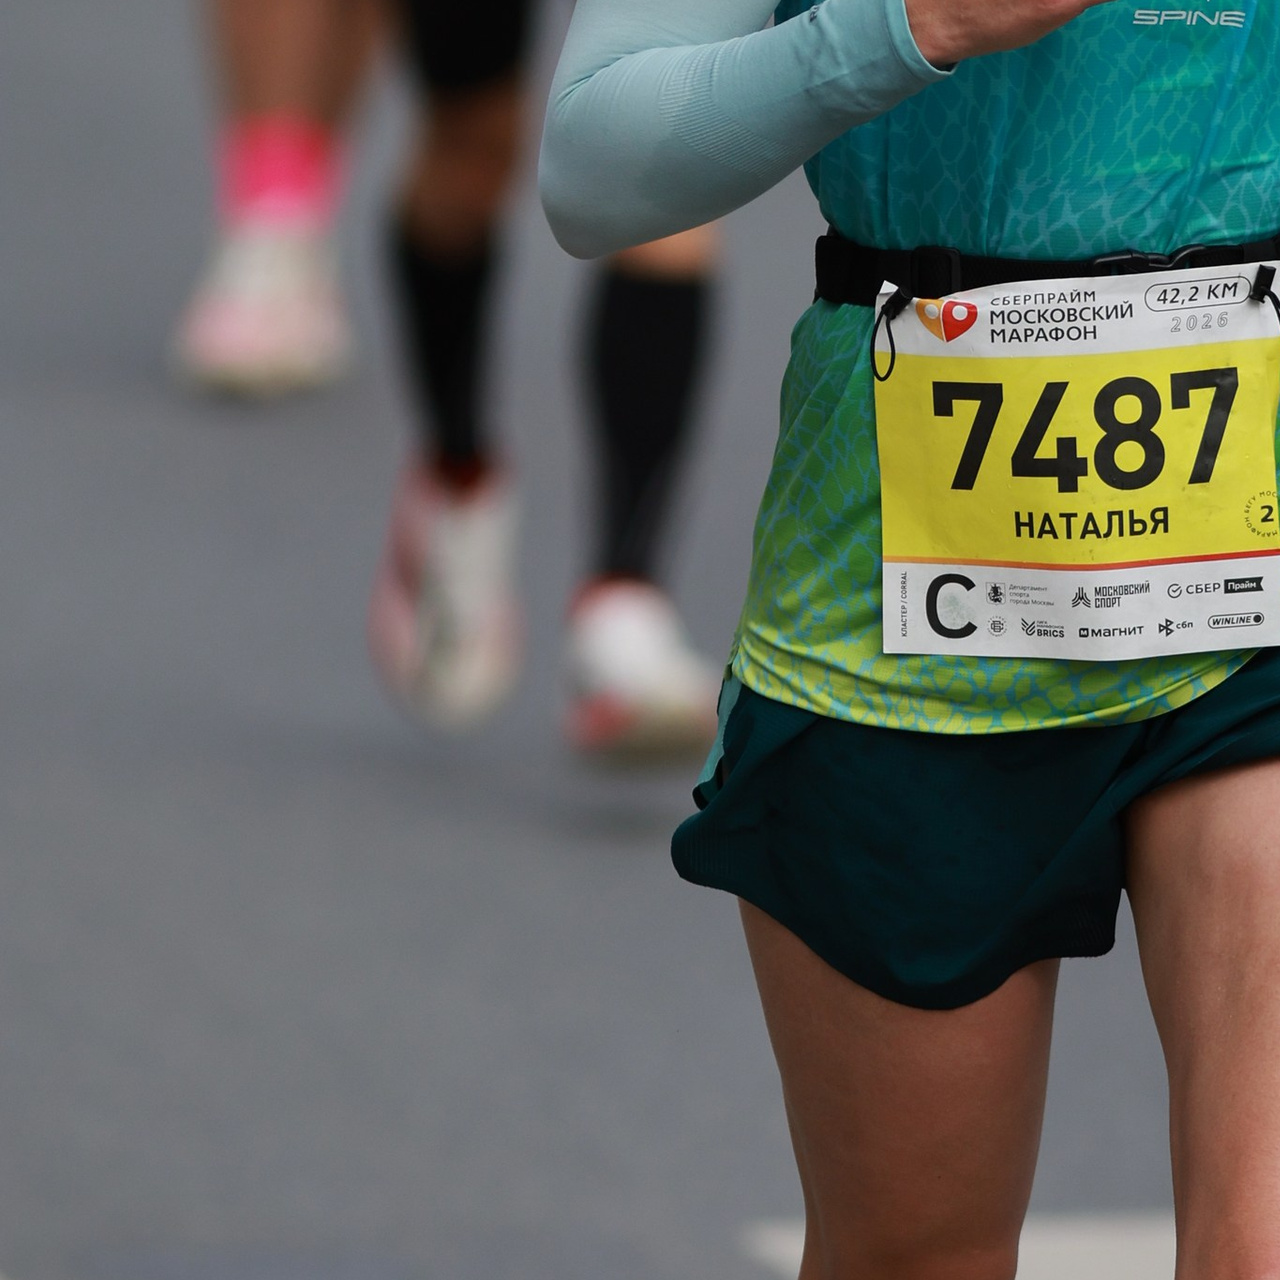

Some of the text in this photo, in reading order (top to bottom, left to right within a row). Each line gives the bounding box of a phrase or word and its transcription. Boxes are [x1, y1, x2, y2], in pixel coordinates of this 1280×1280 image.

[1132, 9, 1246, 28] SPINE
[990, 289, 1096, 306] СБЕРПРАЙМ
[1156, 286, 1199, 306] 42,2
[989, 300, 1134, 325] МОСКОВСКИЙ
[1170, 311, 1229, 333] 2026
[990, 324, 1098, 344] МАРАФОН
[931, 366, 1239, 494] 7487
[1014, 506, 1170, 540] НАТАЛЬЯ
[1260, 504, 1275, 523] 2
[900, 571, 908, 599] CORRAL
[1094, 580, 1151, 596] МОСКОВСКИЙ
[1185, 581, 1257, 595] СБЕР Прайм
[1094, 596, 1122, 609] СПОРТ
[900, 604, 908, 638] КЛАСТЕР
[1175, 620, 1194, 630] сбп
[1212, 616, 1252, 626] WINLINE
[1036, 628, 1065, 638] BRICS
[1090, 625, 1144, 638] магнит
